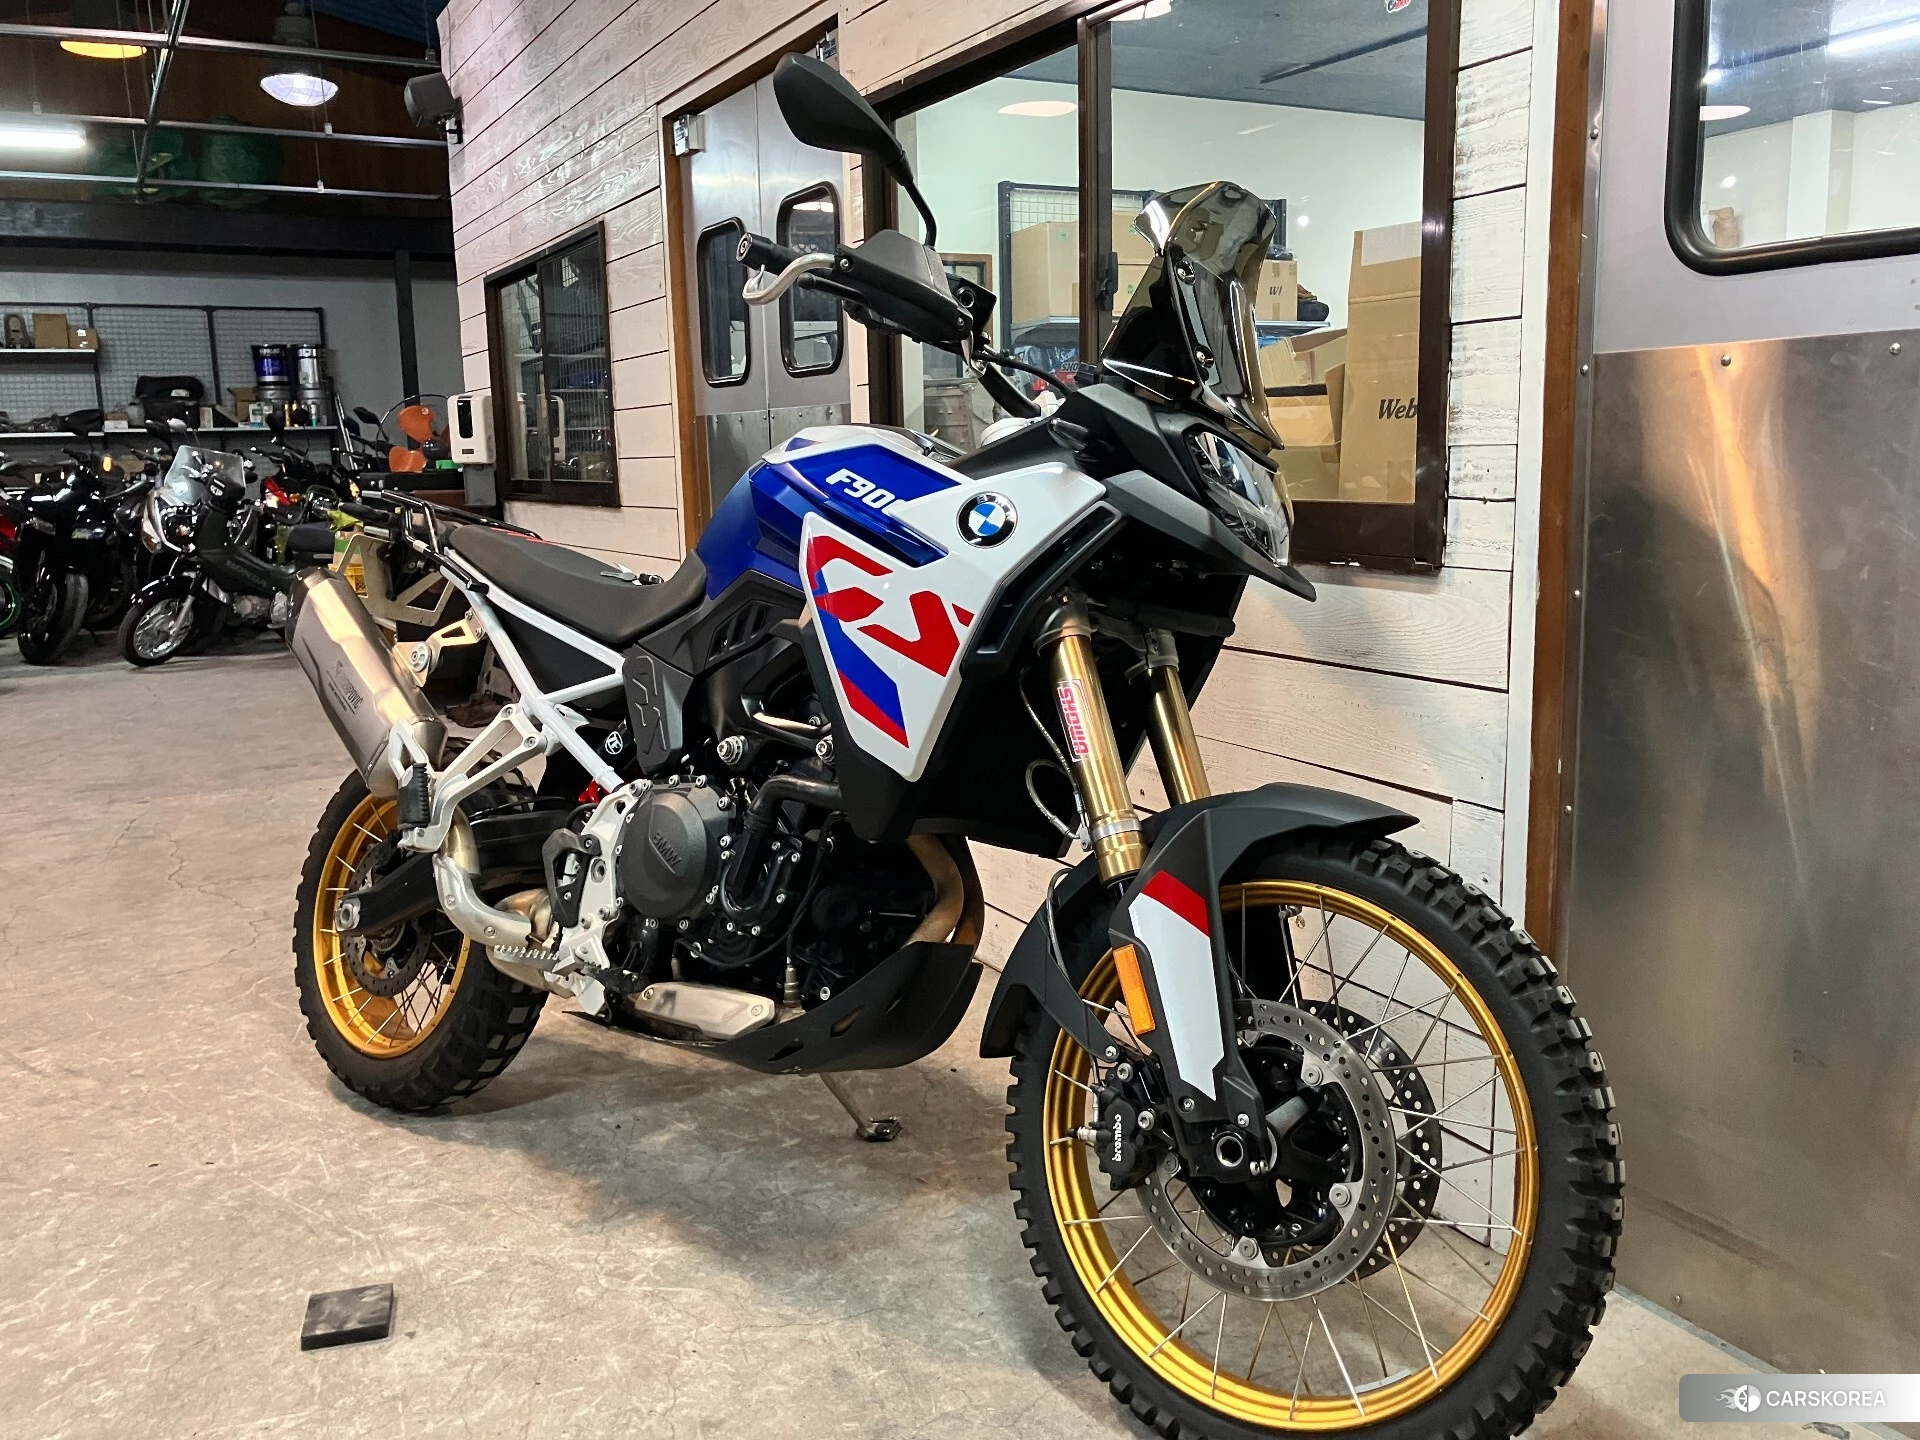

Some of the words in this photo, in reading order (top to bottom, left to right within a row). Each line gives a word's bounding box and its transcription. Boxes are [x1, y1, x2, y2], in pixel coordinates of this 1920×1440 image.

[1378, 397, 1418, 420] Web
[1057, 686, 1090, 755] SHOWA
[652, 832, 683, 868] BMW
[1111, 1113, 1122, 1162] brembo
